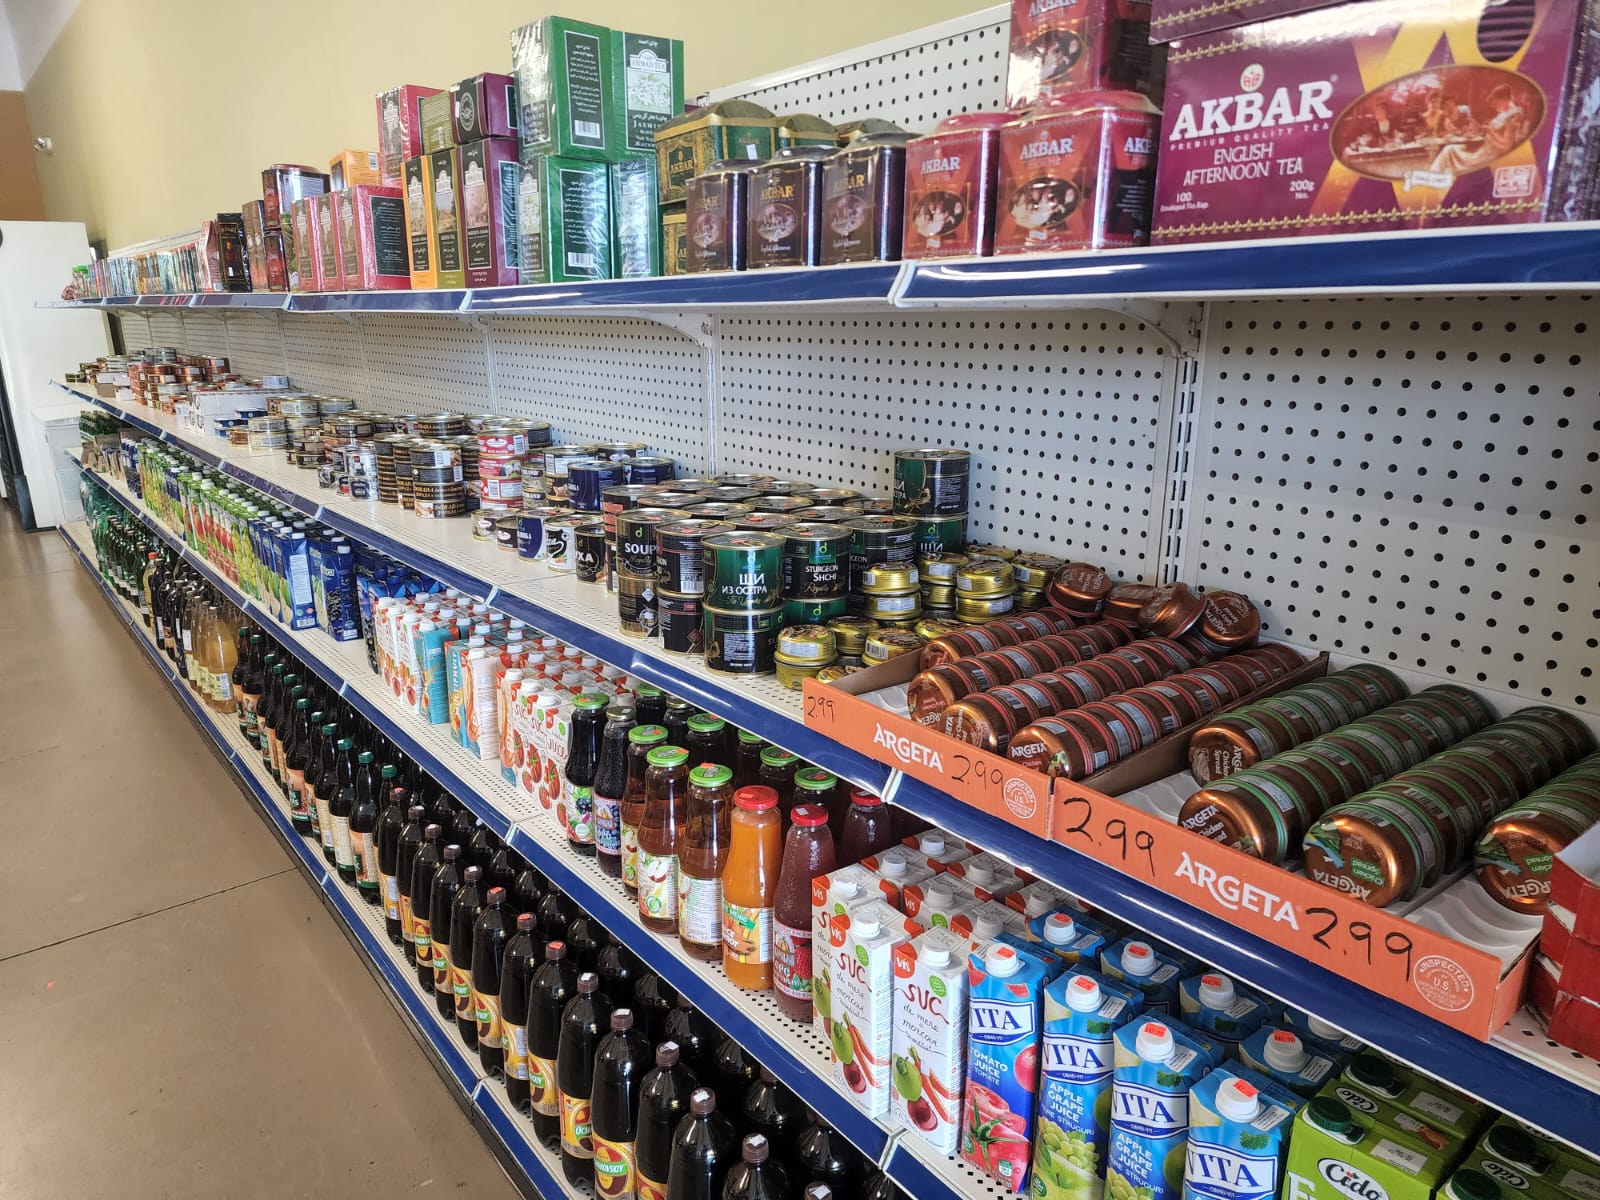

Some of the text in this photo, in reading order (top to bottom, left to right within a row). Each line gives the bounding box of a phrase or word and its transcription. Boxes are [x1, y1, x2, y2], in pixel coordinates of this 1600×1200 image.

[1168, 80, 1334, 142] AKBAR
[1020, 137, 1074, 160] AKBAR
[1170, 122, 1329, 151] PREMIUM QUALITY TEA
[920, 156, 961, 175] AKBAR
[1213, 142, 1275, 165] ENGLISH
[669, 159, 694, 174] AKBAR
[1183, 157, 1304, 187] AFTERNOON TEA
[760, 183, 794, 200] AKBAR
[1176, 191, 1193, 203] 100
[739, 573, 765, 586] ЩИ
[805, 564, 839, 573] STURGEON
[813, 573, 837, 582] SHCHI
[722, 585, 768, 595] ИЗ ОСЕТРА
[807, 695, 836, 723] 2.99
[872, 722, 944, 774] ARGETA
[1011, 743, 1048, 759] ARGETA
[951, 754, 1004, 799] 2.99
[1181, 804, 1219, 830] ARGETA
[1063, 797, 1156, 877] 2.99
[1352, 859, 1381, 875] Spread
[1352, 868, 1384, 886] Chicken
[1174, 852, 1300, 931] ARGETA
[1313, 868, 1372, 901] ARGETA
[1500, 878, 1552, 898] RGETA
[1304, 907, 1414, 983] 2.99
[835, 952, 869, 986] SUC
[896, 956, 910, 972] VIS
[1420, 959, 1470, 987] INSPECTED
[903, 983, 945, 1018] SUC
[971, 1006, 1022, 1031] ITA
[970, 1047, 1008, 1072] TOMATO
[974, 1059, 1001, 1077] JUICE
[974, 1067, 1000, 1086] TOMATE
[1048, 1090, 1084, 1115] GRAPE
[1049, 1081, 1084, 1106] APPLE
[1338, 1089, 1377, 1112] Cido
[1050, 1101, 1080, 1123] JUICE
[1057, 1115, 1095, 1136] STRUGURI
[1115, 1142, 1153, 1172] GRAPE
[1117, 1133, 1153, 1160] APPLE
[1118, 1153, 1149, 1179] JUICE
[1482, 1161, 1528, 1188] Cido
[1125, 1167, 1164, 1194] STRUGURI
[1324, 1162, 1385, 1200] Cido
